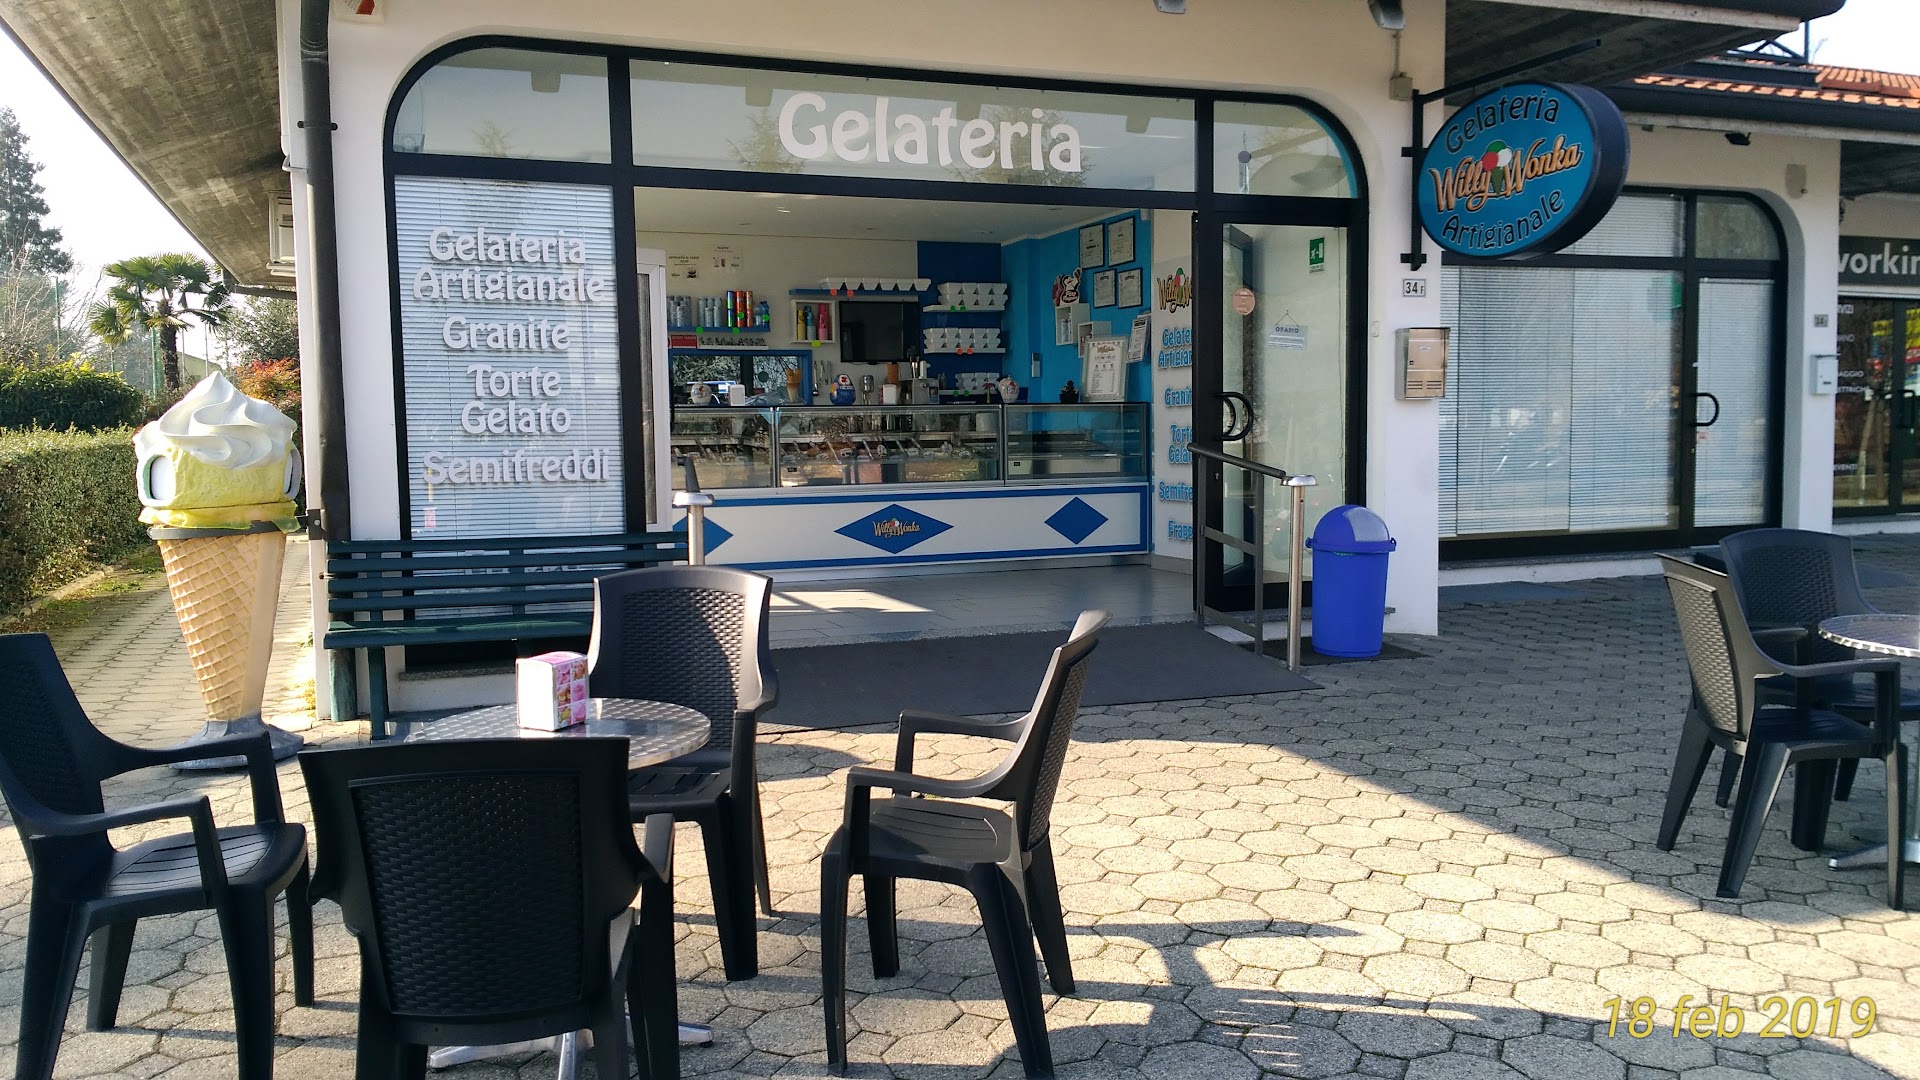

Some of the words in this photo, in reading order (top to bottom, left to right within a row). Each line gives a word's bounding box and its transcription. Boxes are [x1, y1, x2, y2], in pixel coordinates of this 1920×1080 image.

[778, 92, 1081, 172] Gelateria
[1445, 88, 1560, 154] Gelateria
[1428, 156, 1492, 213] Willy
[1504, 134, 1584, 198] Wonka
[1442, 189, 1565, 250] Artigianale
[429, 225, 586, 264] Gelateria
[413, 266, 605, 301] Artigianale
[1405, 281, 1418, 294] 34
[442, 315, 571, 350] Granite
[467, 363, 562, 397] Torte
[461, 400, 572, 434] Gelato
[422, 449, 611, 484] Semifreddi
[897, 520, 920, 536] Wonka
